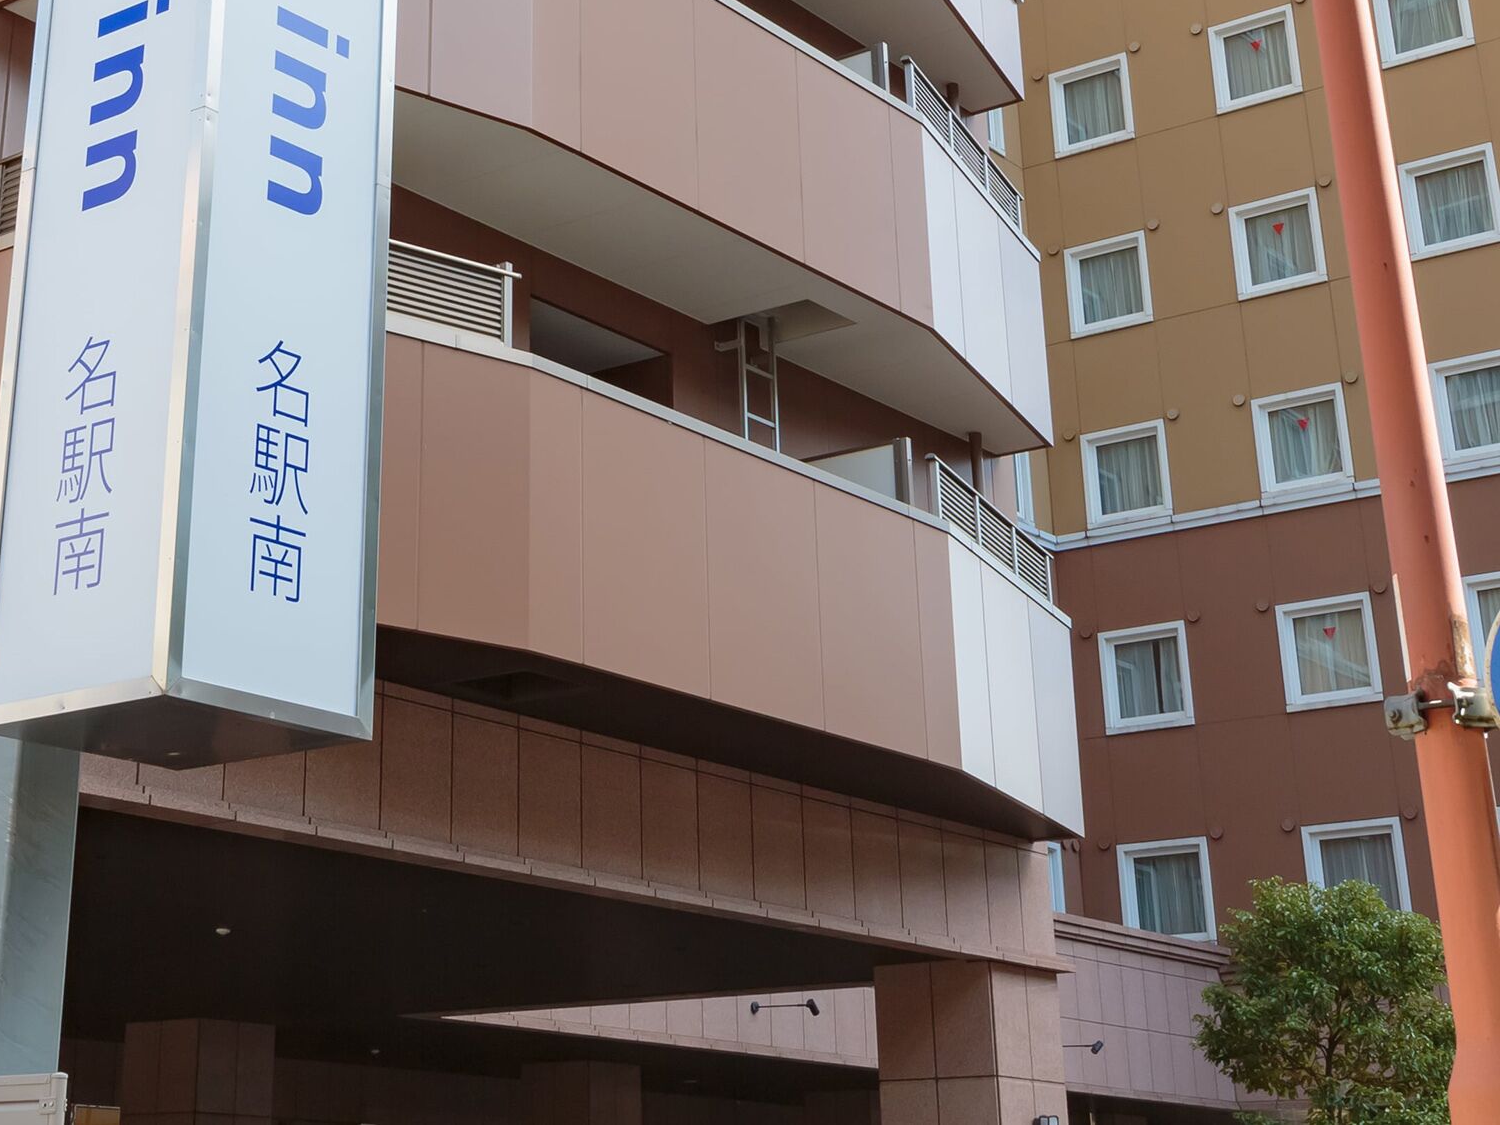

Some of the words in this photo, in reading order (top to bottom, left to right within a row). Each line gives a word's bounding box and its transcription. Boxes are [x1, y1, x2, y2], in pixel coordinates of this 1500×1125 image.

[266, 6, 350, 218] inn
[53, 336, 118, 598] 名駅南
[249, 340, 311, 604] 名駅南
